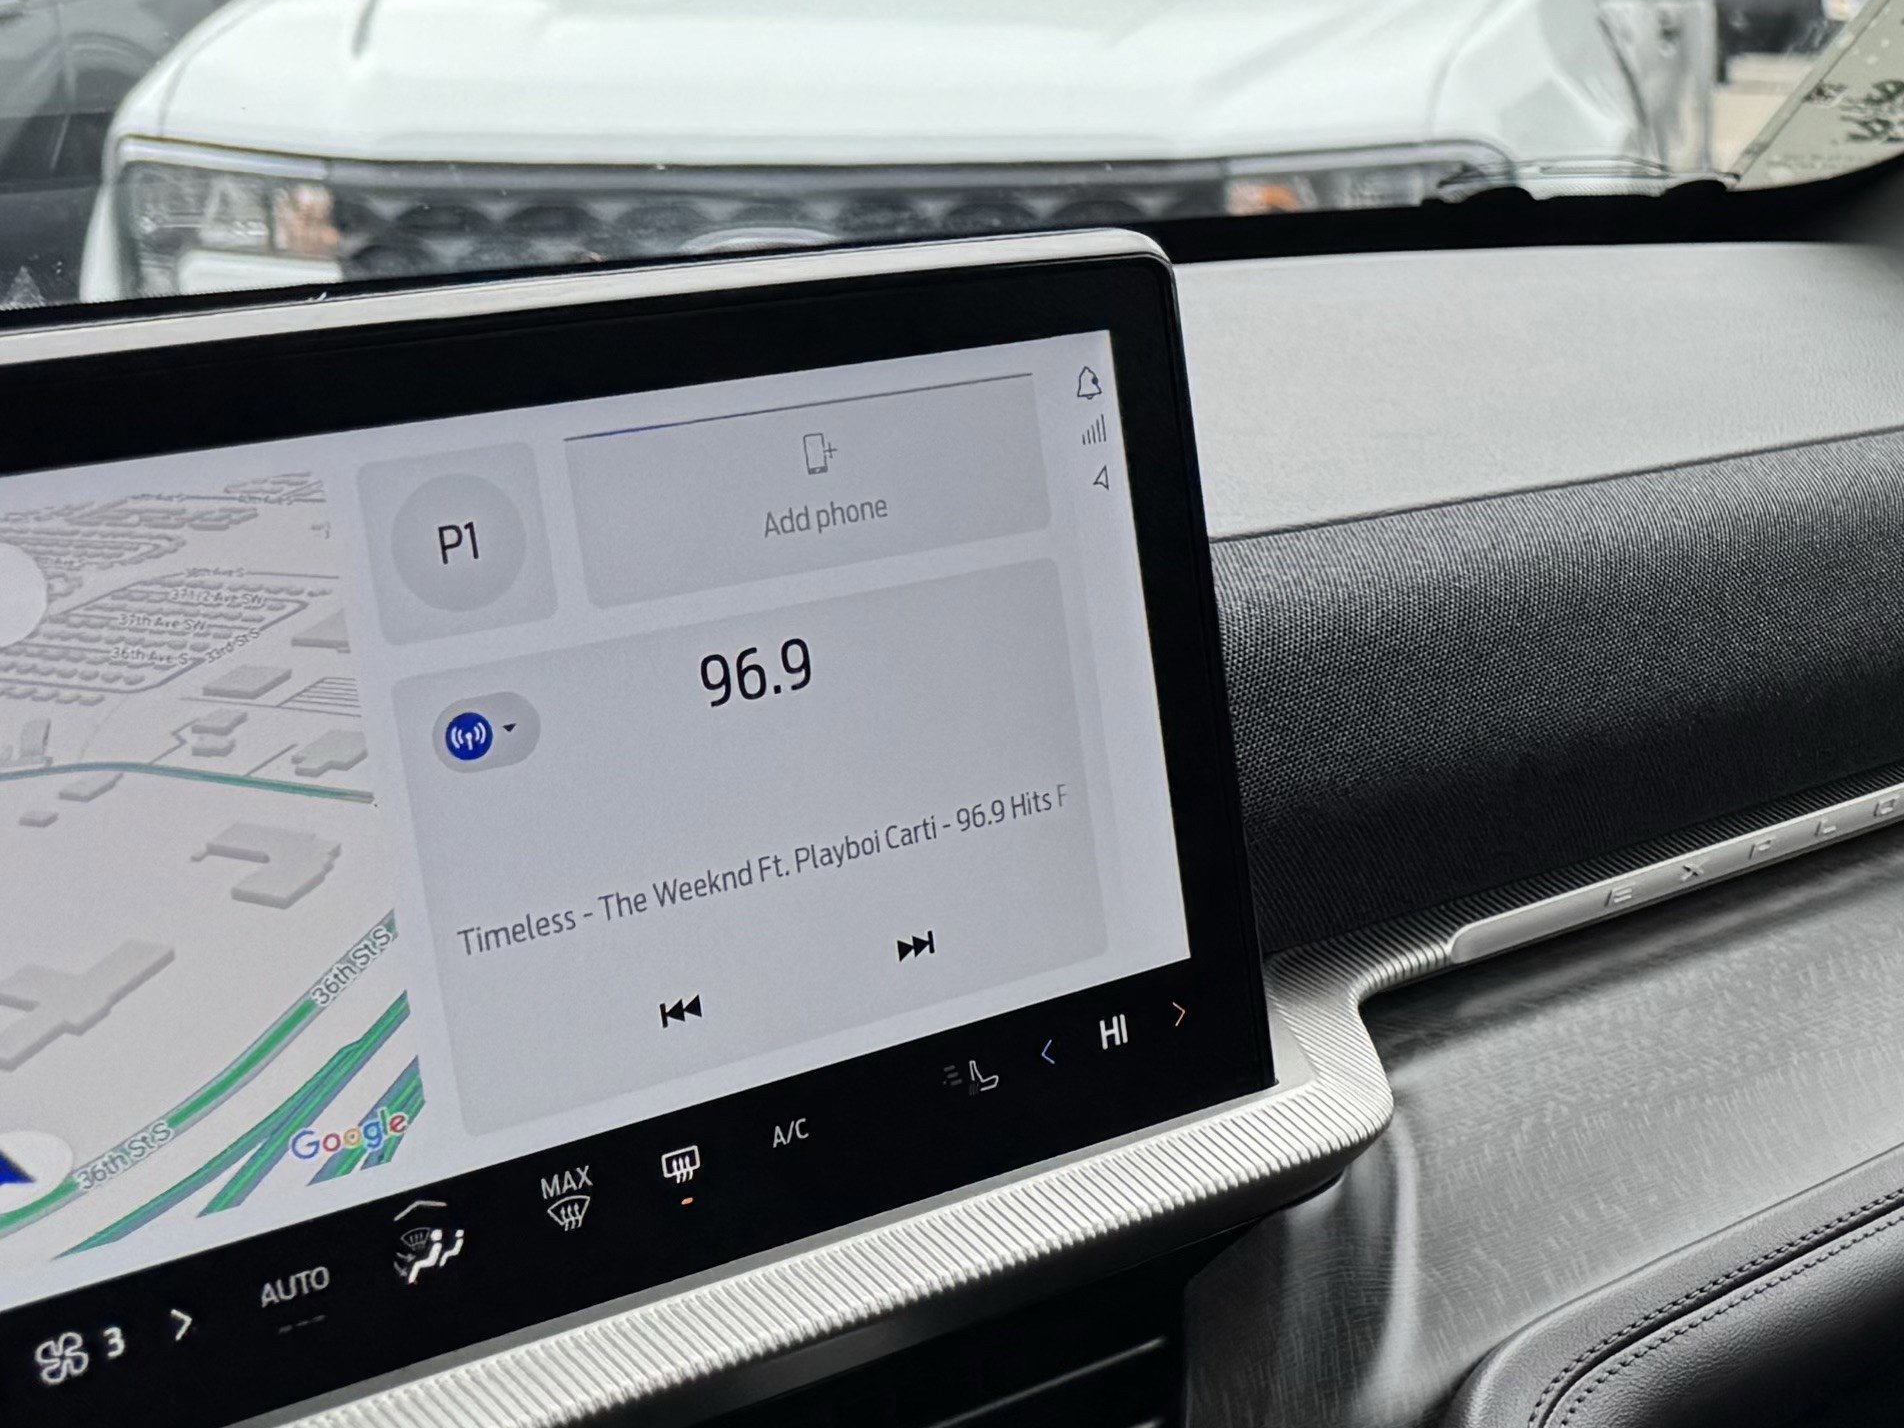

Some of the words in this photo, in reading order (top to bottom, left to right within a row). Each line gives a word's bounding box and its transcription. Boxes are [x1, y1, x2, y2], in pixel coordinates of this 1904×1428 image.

[763, 509, 810, 539] Add
[816, 497, 888, 535] phone
[438, 520, 480, 565] P1
[119, 614, 151, 627] 37th
[154, 617, 181, 630] Ave
[111, 647, 145, 660] 36th
[148, 650, 177, 662] Ave
[206, 641, 236, 663] 33rd
[699, 638, 812, 709] 96.9
[458, 911, 577, 957] Timeless
[599, 889, 648, 922] The
[653, 861, 753, 907] Weeknd
[758, 853, 791, 884] Ft.
[794, 830, 882, 873] Playboi
[885, 815, 938, 850] Carti
[956, 799, 1005, 833] 96.9
[1010, 789, 1053, 821] Hits
[311, 958, 357, 1007] 36th
[352, 942, 377, 970] St
[372, 925, 392, 948] S
[1100, 1014, 1128, 1049] HI
[291, 1107, 408, 1161] Google
[772, 1118, 809, 1149] A/C
[77, 1149, 128, 1192] 36th
[126, 1136, 153, 1162] St
[150, 1121, 174, 1145] S
[539, 1166, 593, 1200] MAX
[260, 1267, 330, 1307] AUTO
[103, 1326, 126, 1359] 3
